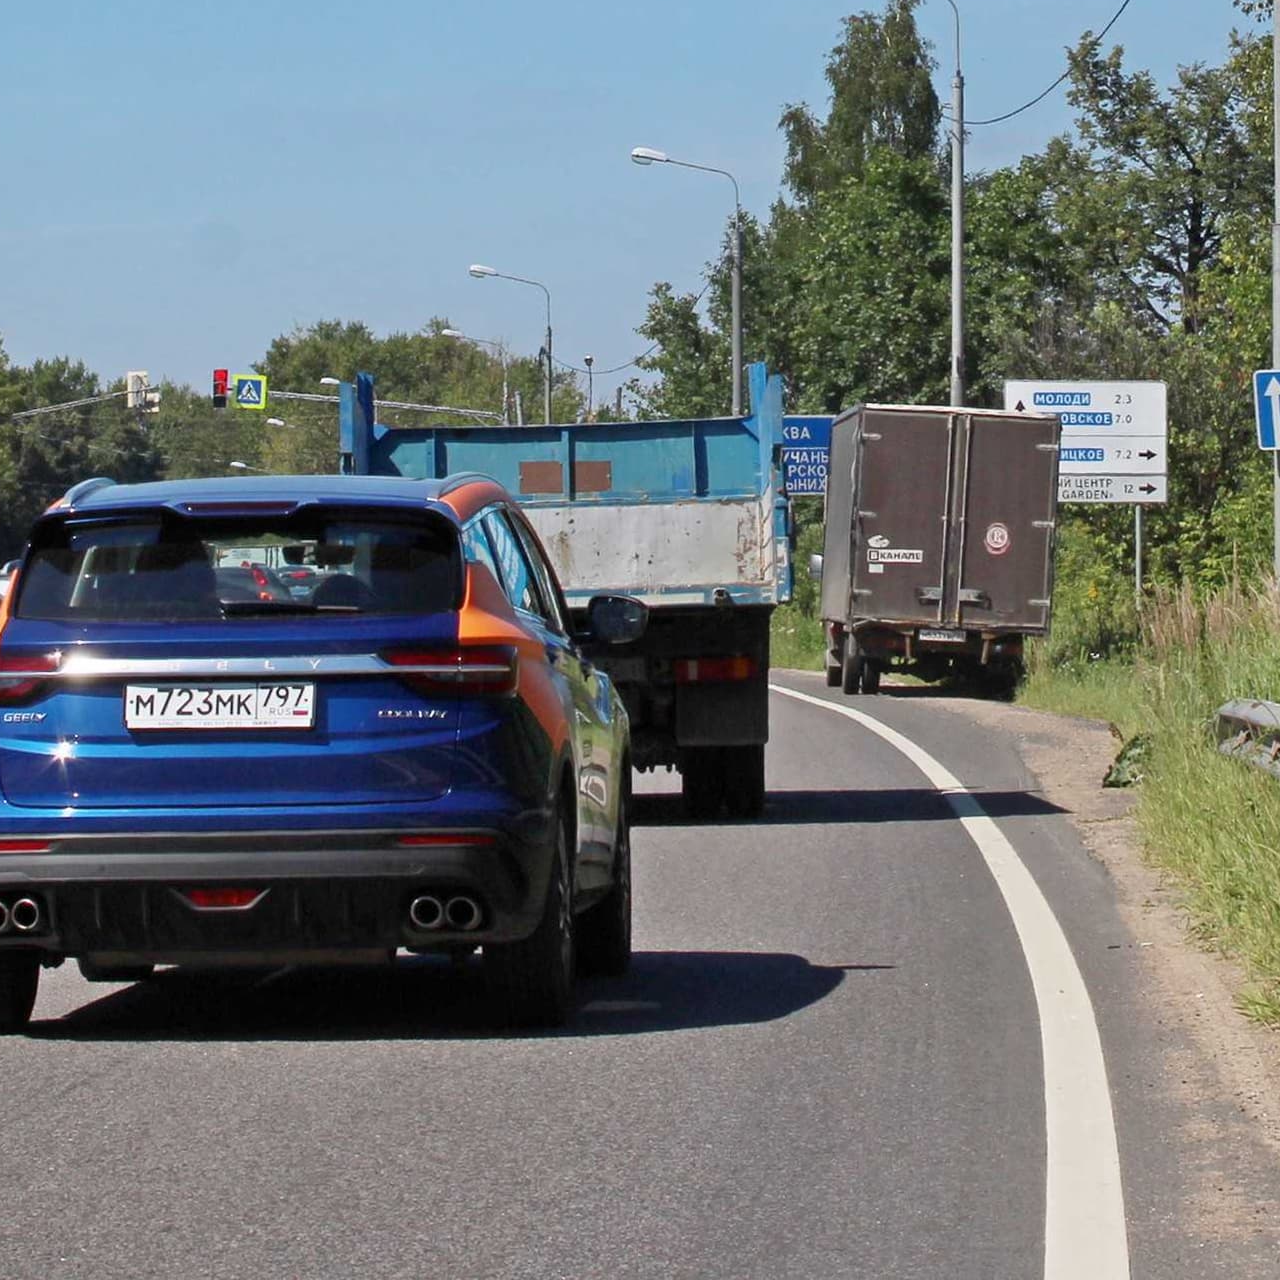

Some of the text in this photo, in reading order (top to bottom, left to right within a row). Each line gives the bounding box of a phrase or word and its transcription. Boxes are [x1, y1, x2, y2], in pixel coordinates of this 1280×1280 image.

[1035, 394, 1132, 405] МОЛОДИ 2.3
[1061, 414, 1132, 424] ОВСКОЕ 7.0
[782, 426, 811, 439] КВА
[1061, 449, 1132, 461] ИЦКОЕ 7.2
[788, 465, 827, 477] РСКО
[786, 478, 826, 490] ЫНИХ
[1075, 478, 1112, 489] ЦЕНТР
[1124, 484, 1134, 493] 12
[135, 685, 305, 716] М723МК 797
[3, 712, 47, 722] GEELY
